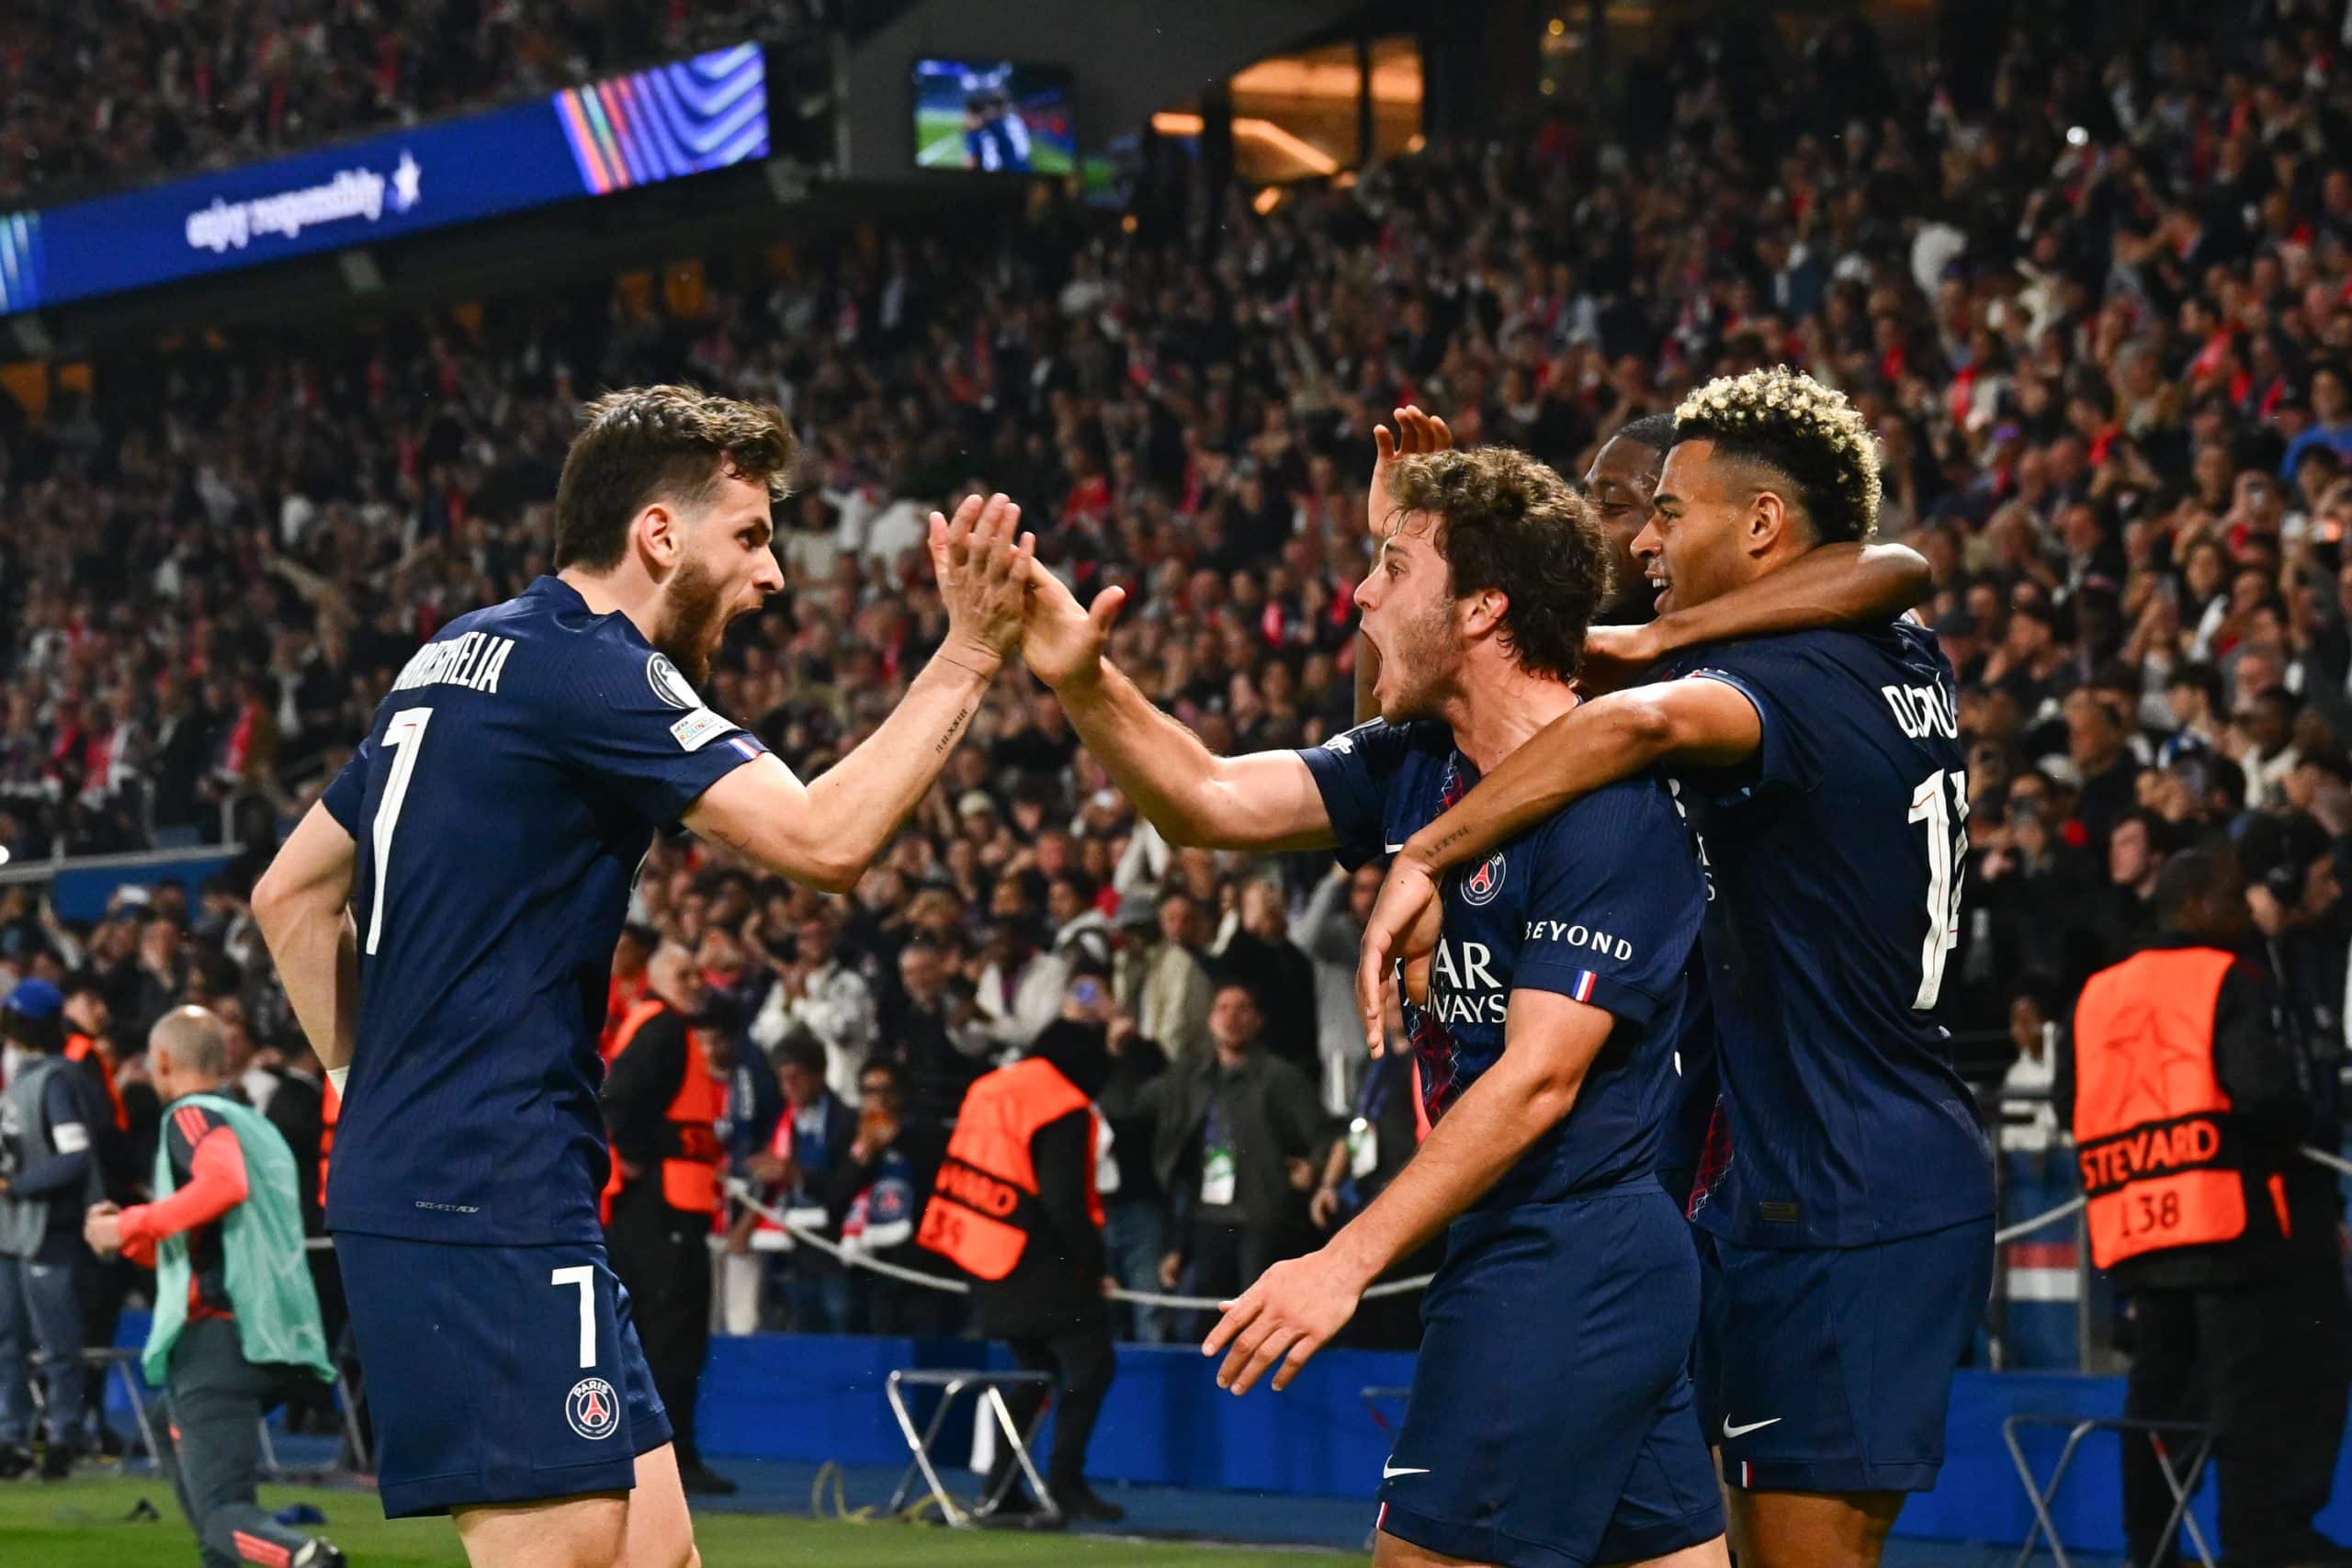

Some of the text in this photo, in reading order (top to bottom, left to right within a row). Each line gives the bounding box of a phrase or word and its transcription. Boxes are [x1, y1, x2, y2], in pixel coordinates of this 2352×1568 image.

[366, 706, 434, 955] 7
[1525, 920, 1633, 962] BEYOND
[551, 1265, 596, 1369] 7
[573, 1381, 609, 1398] PARIS
